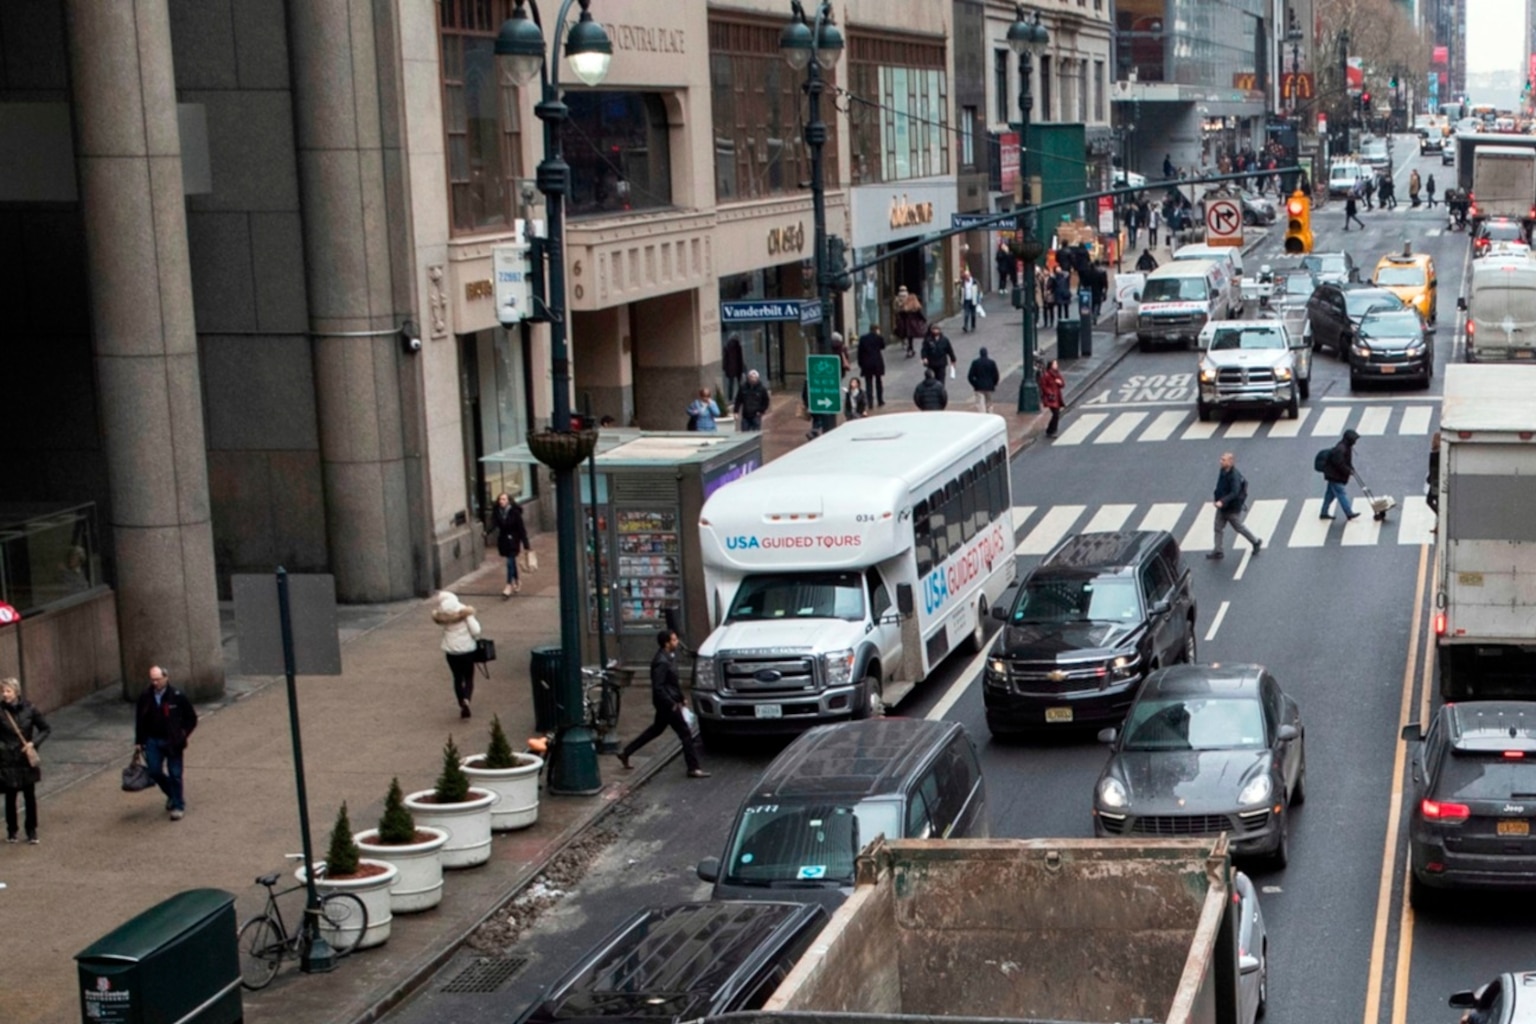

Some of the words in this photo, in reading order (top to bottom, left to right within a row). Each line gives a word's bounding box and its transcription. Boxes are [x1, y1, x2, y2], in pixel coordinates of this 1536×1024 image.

[724, 305, 782, 317] Vanderbilt
[784, 304, 799, 316] Av
[1123, 373, 1194, 388] BUS
[1085, 387, 1188, 404] ONLY
[856, 514, 875, 522] 034
[726, 535, 760, 549] USA
[761, 536, 813, 548] GUIDED
[816, 535, 861, 548] TOURS
[923, 566, 949, 615] USA
[947, 547, 979, 595] GUIDED
[978, 524, 1005, 573] TOURS
[1503, 804, 1524, 812] Jeep
